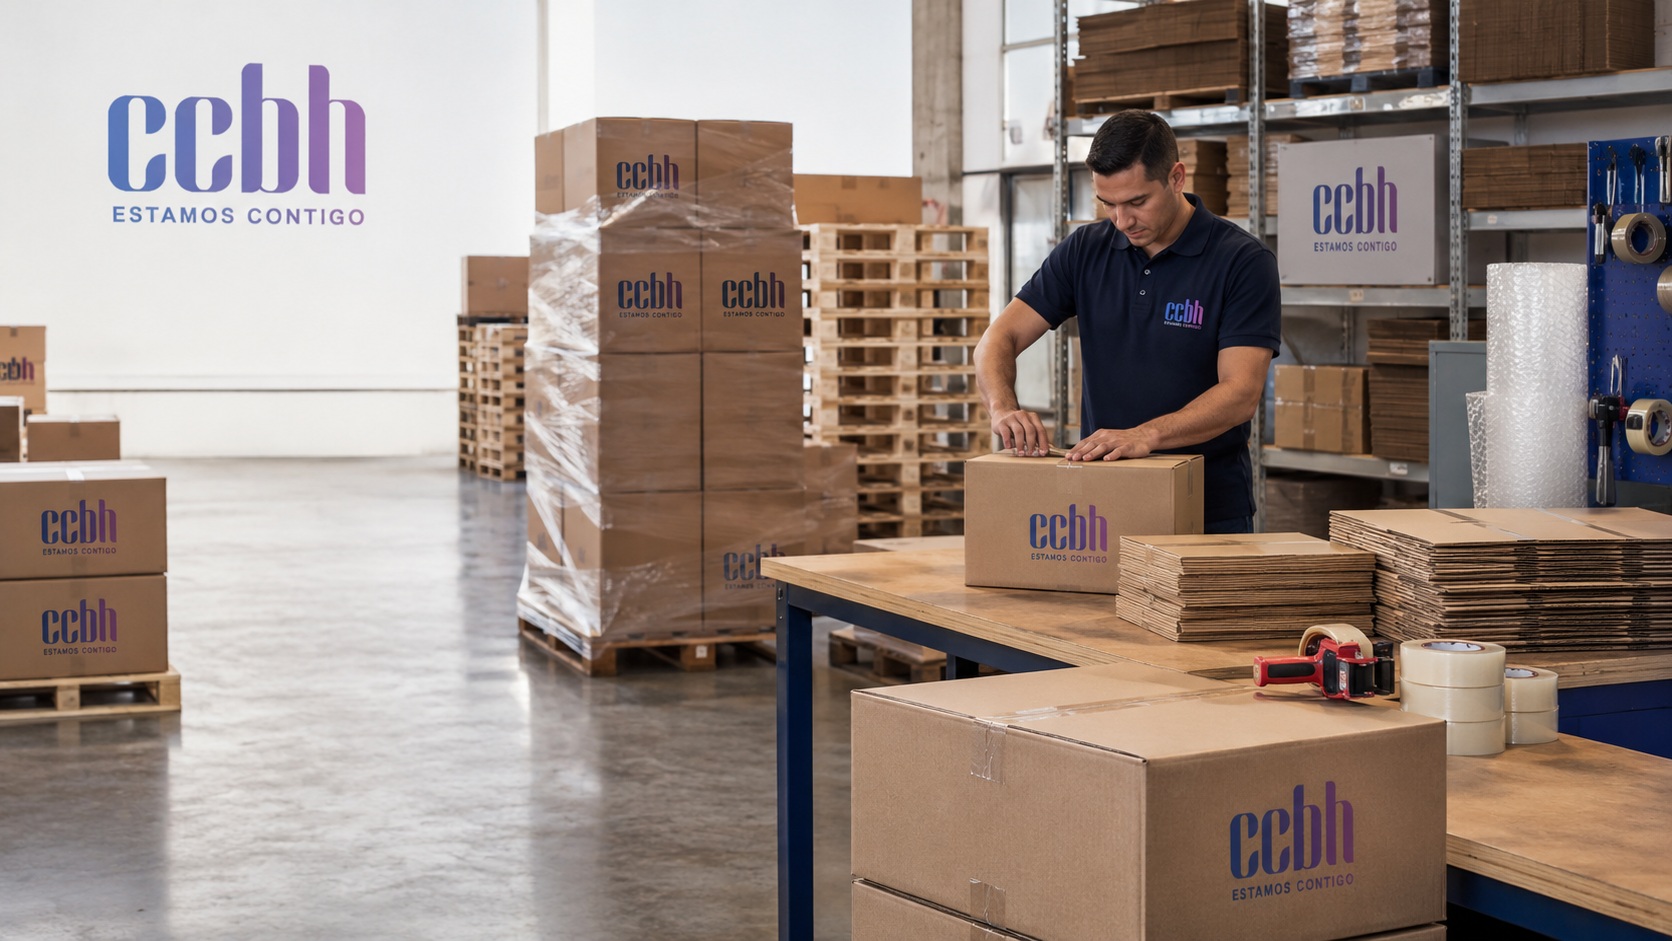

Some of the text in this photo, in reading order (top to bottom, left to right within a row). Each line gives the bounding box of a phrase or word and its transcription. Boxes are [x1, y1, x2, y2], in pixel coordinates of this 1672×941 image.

[108, 63, 366, 195] ccbh
[616, 154, 679, 190] ccbh
[112, 206, 365, 226] ESTAMOS CONTIGO
[1313, 166, 1398, 235] ccbh
[1314, 241, 1397, 252] ESTAMOS CONTIGO
[618, 272, 682, 309] ccbh
[722, 272, 785, 308] ccbh
[1165, 299, 1204, 325] ccbh
[41, 499, 117, 544] ccbh
[1029, 504, 1108, 552] ccbh
[1031, 553, 1107, 563] ESTAMOS CONTIGO
[42, 598, 117, 644] ccbh
[1229, 781, 1354, 879] ccbh
[1232, 873, 1354, 901] ESTAMOS CONTIGO
